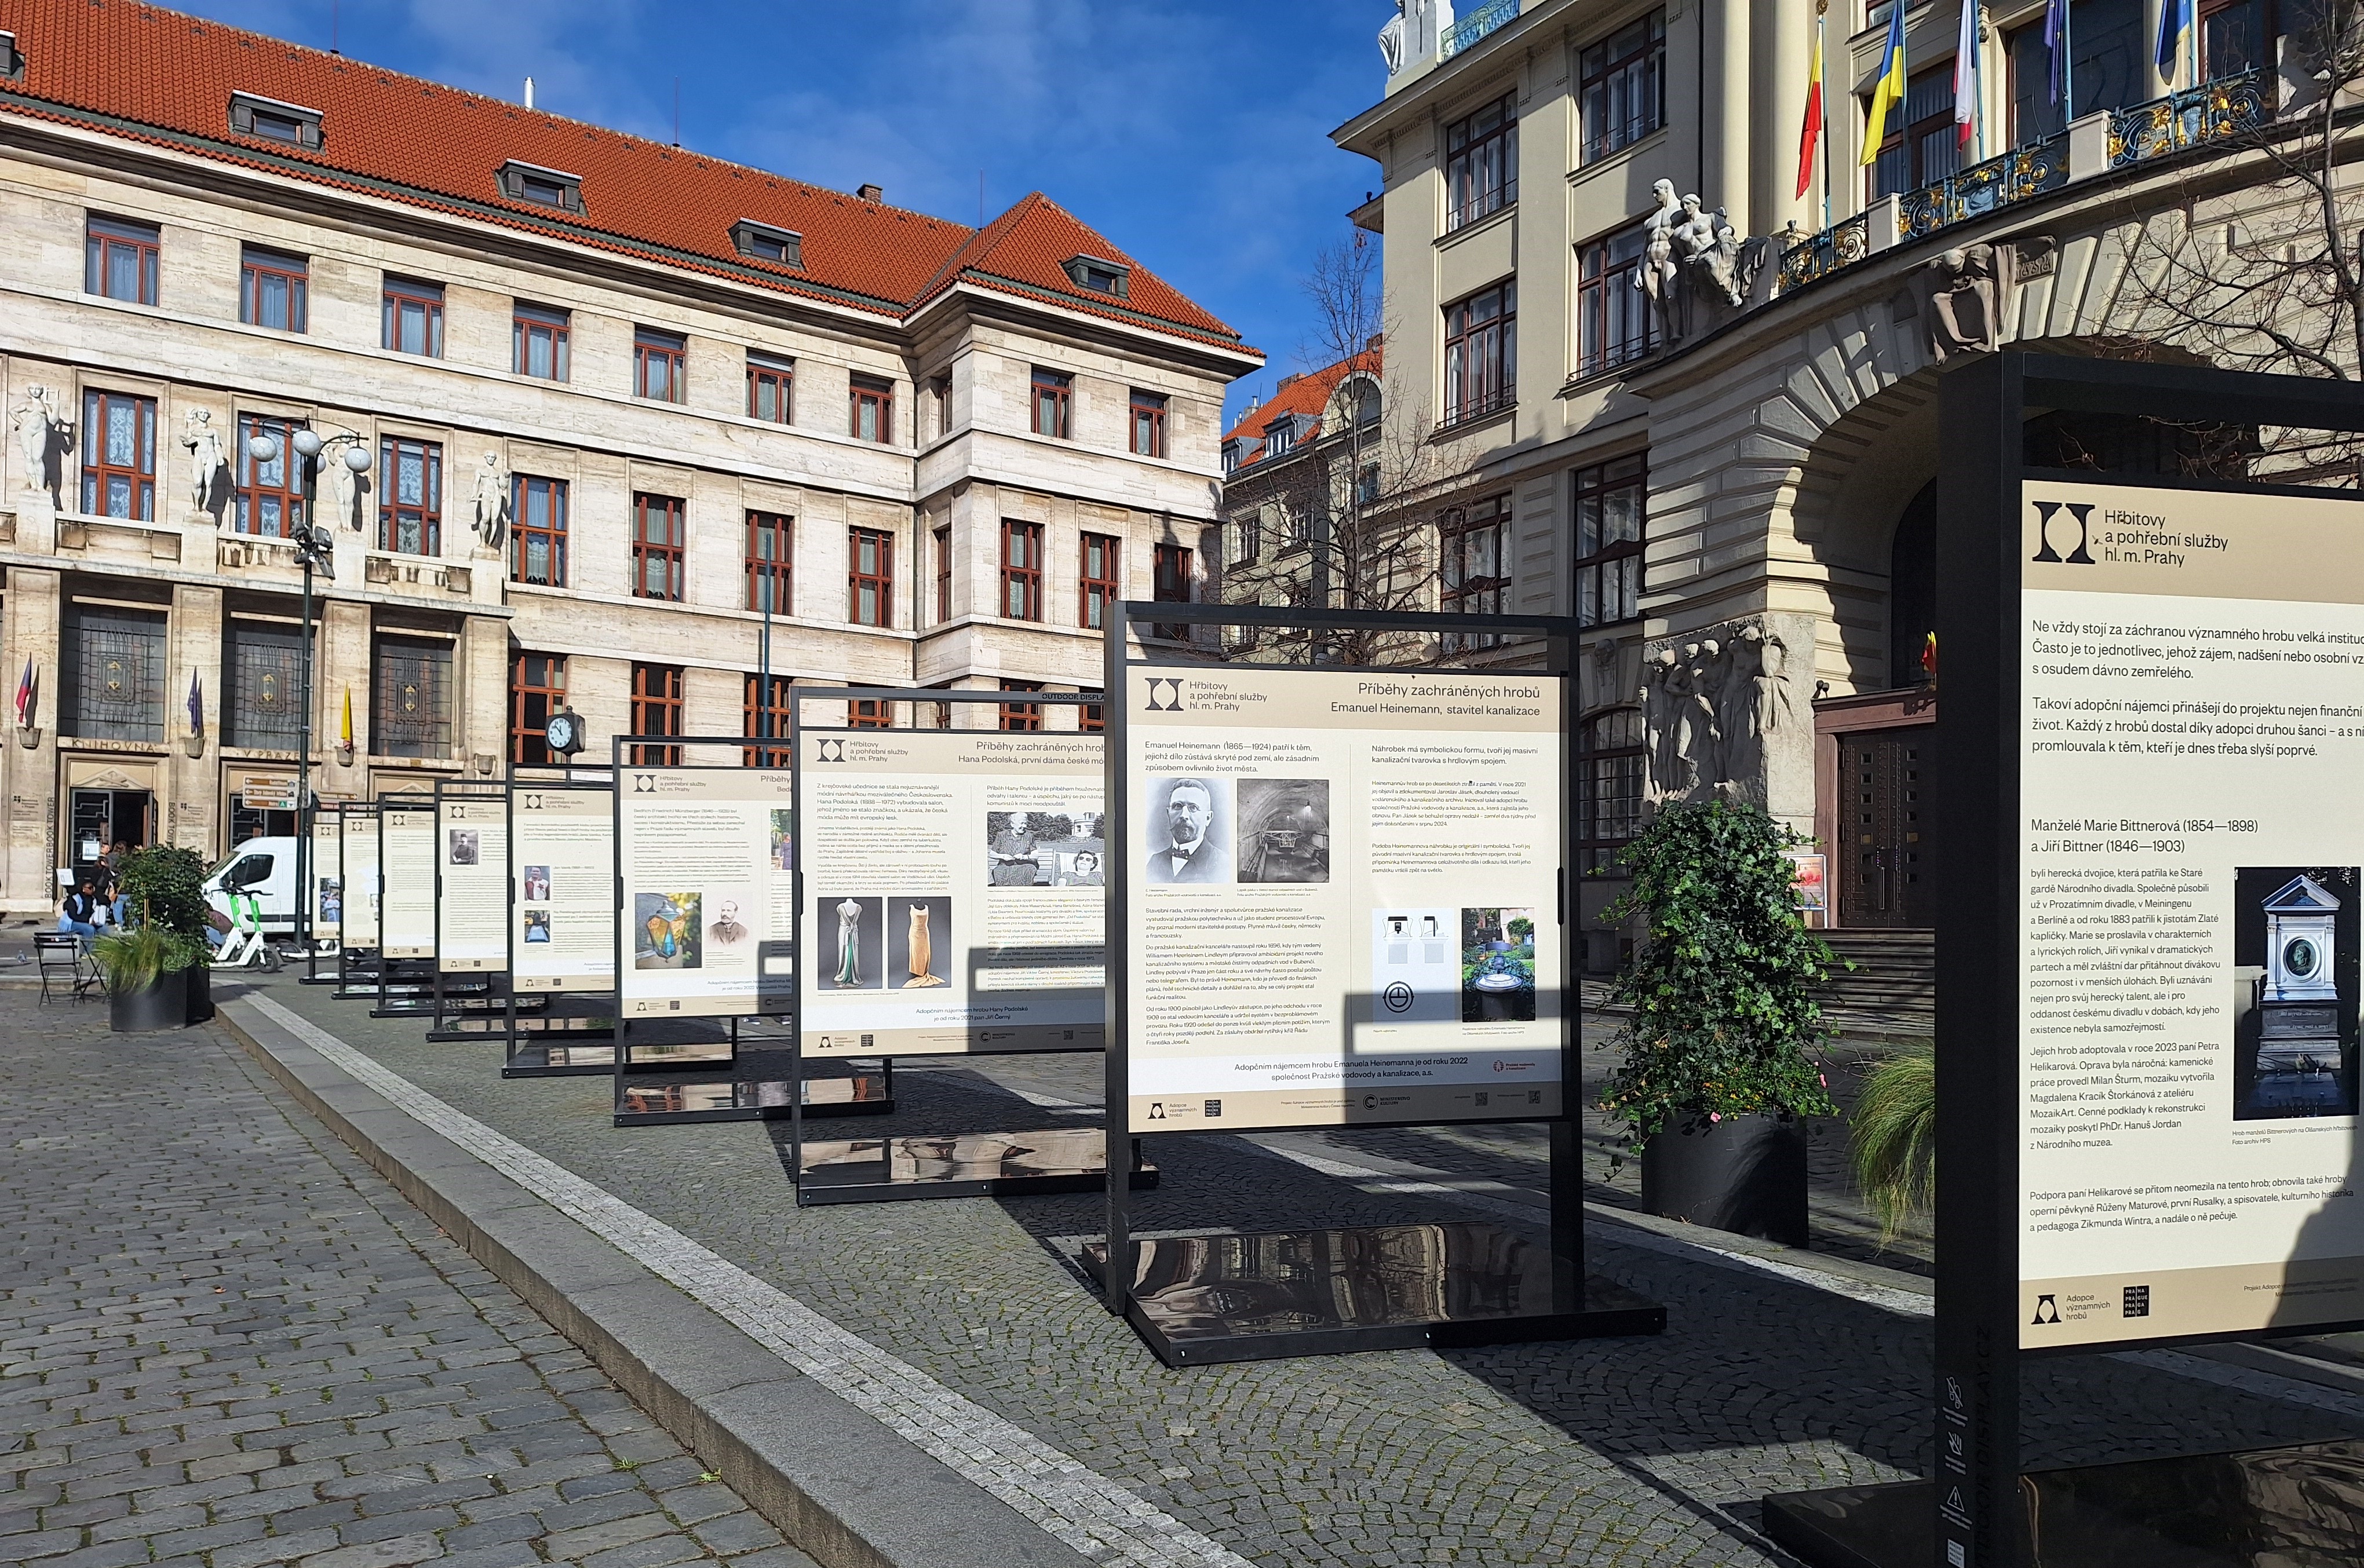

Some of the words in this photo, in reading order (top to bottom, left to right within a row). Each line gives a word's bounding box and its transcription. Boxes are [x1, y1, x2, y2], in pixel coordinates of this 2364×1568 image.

[2106, 510, 2165, 529] Hřbitovy
[2106, 532, 2113, 542] a
[2118, 530, 2181, 546] pohřební
[2185, 533, 2228, 551] služby
[2106, 547, 2119, 561] hl.
[2125, 552, 2140, 562] m.
[2145, 550, 2184, 568] Prahy
[2033, 620, 2049, 632] Ne
[2052, 621, 2080, 635] vždy
[2082, 623, 2107, 637] stojí
[2110, 626, 2122, 635] za
[2125, 624, 2185, 637] záchranou
[2188, 627, 2259, 640] významného
[2263, 629, 2294, 641] hrobu
[2297, 631, 2325, 642] velká
[2033, 638, 2068, 653] Často
[2070, 642, 2081, 656] je
[2084, 644, 2095, 655] to
[2097, 644, 2164, 659] jednotlivec,
[2165, 646, 2197, 660] jehož
[2199, 647, 2235, 661] zájem,
[2238, 649, 2281, 661] nadšení
[2284, 650, 2311, 662] nebo
[2314, 652, 2350, 663] osobní
[2033, 666, 2038, 674] s
[2042, 663, 2089, 675] osudem
[2093, 664, 2128, 676] dávno
[2132, 666, 2193, 678] zemřelého.
[1190, 681, 1227, 691] Hřbitovy
[1359, 683, 1407, 698] Příběhy
[1411, 685, 1500, 699] zachráněných
[1504, 686, 1539, 697] hrobů
[1198, 692, 1237, 701] pohřební
[1240, 693, 1267, 702] služby
[1215, 702, 1239, 712] Prahy
[1331, 702, 1377, 712] Emanuel
[1381, 703, 1442, 715] Heinemann,
[1447, 705, 1483, 714] stavitel
[1487, 706, 1539, 715] kanalizace
[2033, 697, 2071, 709] Takoví
[2074, 699, 2122, 713] adopční
[2125, 700, 2169, 714] nájemci
[2173, 701, 2220, 716] přinášejí
[2223, 702, 2237, 714] do
[2241, 703, 2285, 717] projektu
[2289, 704, 2317, 718] nejen
[2320, 705, 2362, 717] finanční
[72, 740, 155, 753] KNIHOVNA
[977, 741, 1013, 752] Příběhy
[1016, 743, 1083, 753] zachráněných
[1224, 741, 1271, 751] (1865—1924)
[1022, 756, 1041, 765] první
[761, 776, 790, 784] Příběhy
[2032, 819, 2081, 831] Manželé
[2085, 820, 2117, 831] Marie
[2121, 820, 2180, 831] Bittnerová
[2183, 820, 2257, 833] (1854—1898)
[2031, 843, 2038, 851] a
[2041, 840, 2060, 851] Jiří
[2063, 840, 2103, 851] Bittner
[2107, 840, 2184, 853] (1846—1903)
[2031, 869, 2045, 879] byli
[2048, 869, 2082, 877] herecká
[2084, 869, 2115, 879] dvojice,
[2142, 869, 2167, 879] patřila
[2169, 868, 2179, 876] ke
[2181, 868, 2202, 876] Staré
[2030, 1047, 2055, 1057] Jejich
[2058, 1046, 2077, 1054] hrob
[2080, 1045, 2126, 1055] adoptovala
[2155, 1043, 2176, 1051] 2023
[2179, 1042, 2196, 1052] paní
[1235, 1063, 1271, 1072] Adopčním
[1415, 1059, 1422, 1068] je
[1272, 1073, 1310, 1081] společnost
[1342, 1070, 1376, 1079] vodovody
[2037, 1222, 2079, 1233] pedagoga
[2081, 1218, 2122, 1228] Zikmunda
[2125, 1217, 2153, 1225] Wintra,
[2162, 1214, 2188, 1223] nadále
[2198, 1213, 2207, 1221] ně
[2210, 1211, 2237, 1222] pečuje.
[2066, 1302, 2110, 1312] významných
[2067, 1312, 2086, 1320] hrobů
